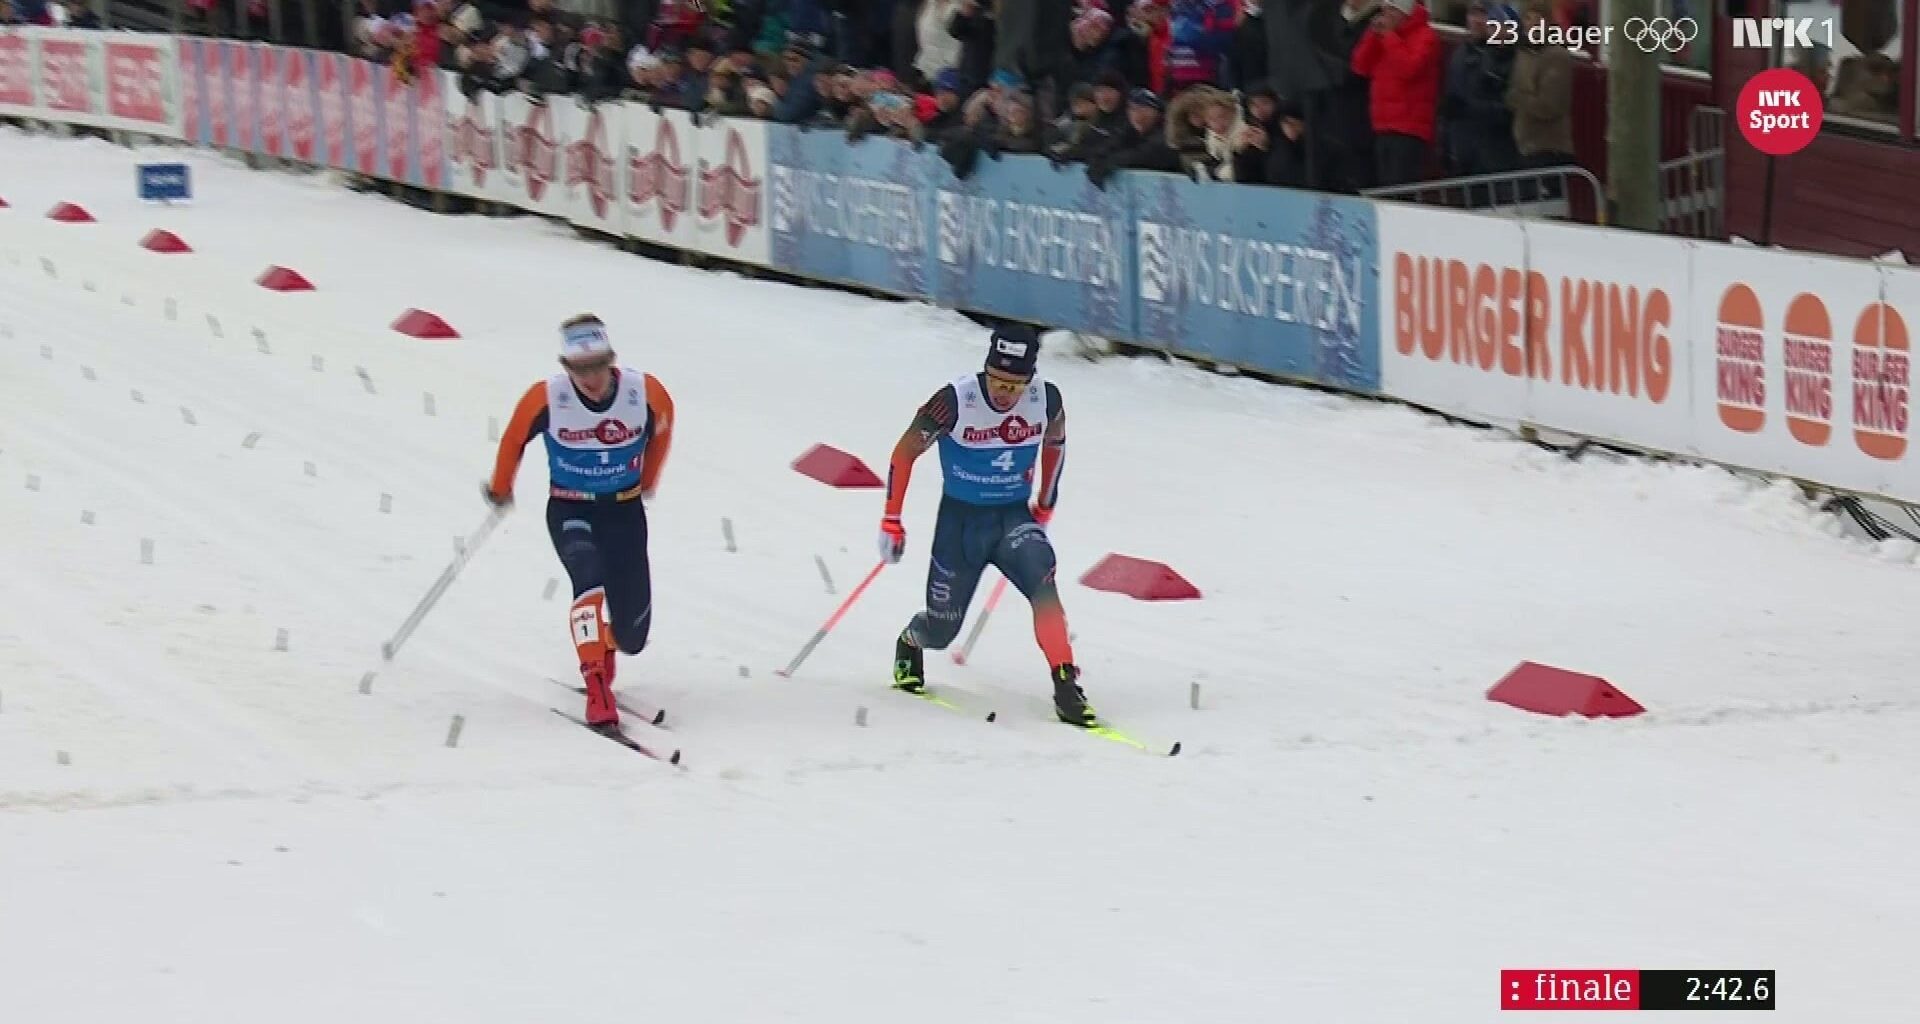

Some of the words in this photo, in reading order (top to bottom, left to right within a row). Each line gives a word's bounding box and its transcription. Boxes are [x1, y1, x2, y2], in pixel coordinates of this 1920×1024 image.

[1394, 251, 1552, 382] BURGER
[1560, 276, 1672, 405] KING
[1717, 327, 1765, 361] BURGER
[1784, 337, 1832, 374] BURGER
[1853, 347, 1910, 385] BURGER
[1717, 359, 1766, 407] KING
[1785, 371, 1833, 421] KING
[1853, 382, 1909, 433] KING
[597, 451, 609, 465] 1
[991, 449, 1015, 471] 4
[581, 624, 588, 637] 1
